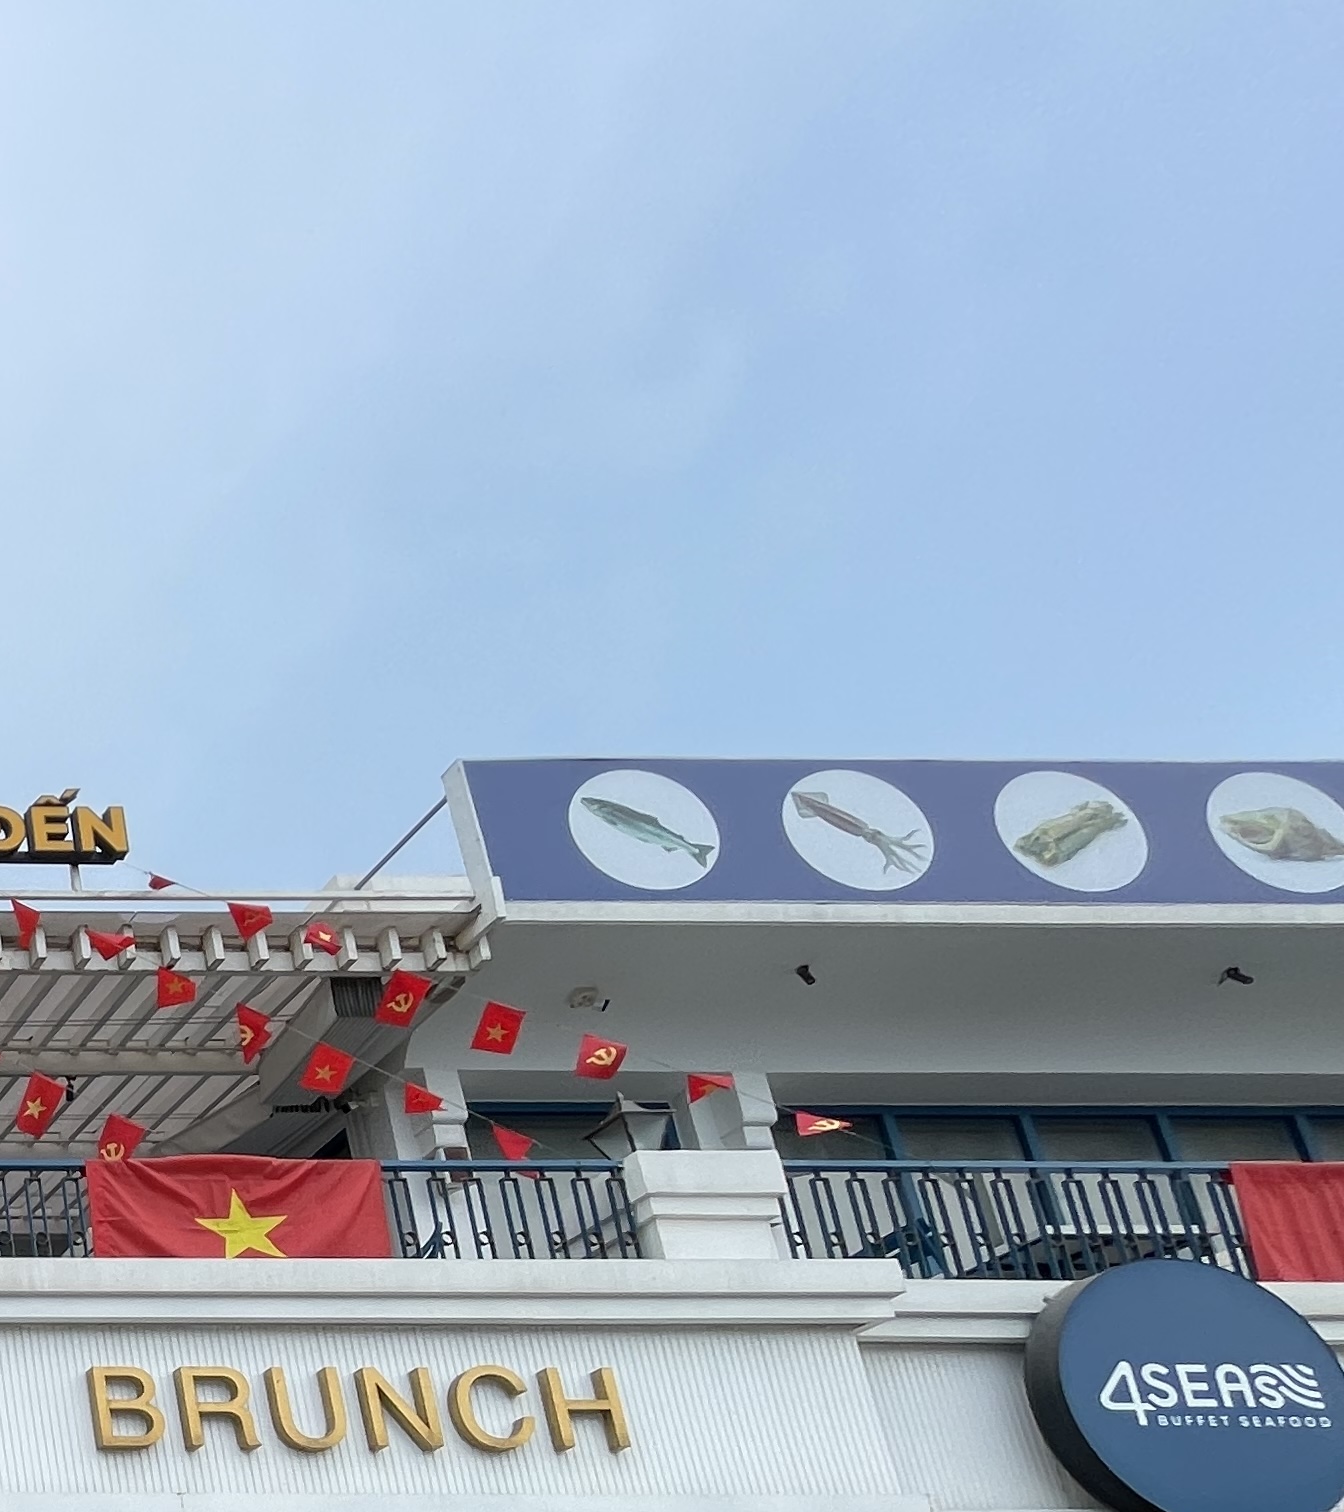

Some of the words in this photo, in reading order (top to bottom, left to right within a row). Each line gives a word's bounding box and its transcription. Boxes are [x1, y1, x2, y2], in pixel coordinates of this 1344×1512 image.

[86, 1364, 631, 1454] BRUNCH
[1158, 1415, 1229, 1428] BUFFET
[1239, 1415, 1333, 1429] SEAFOOD
